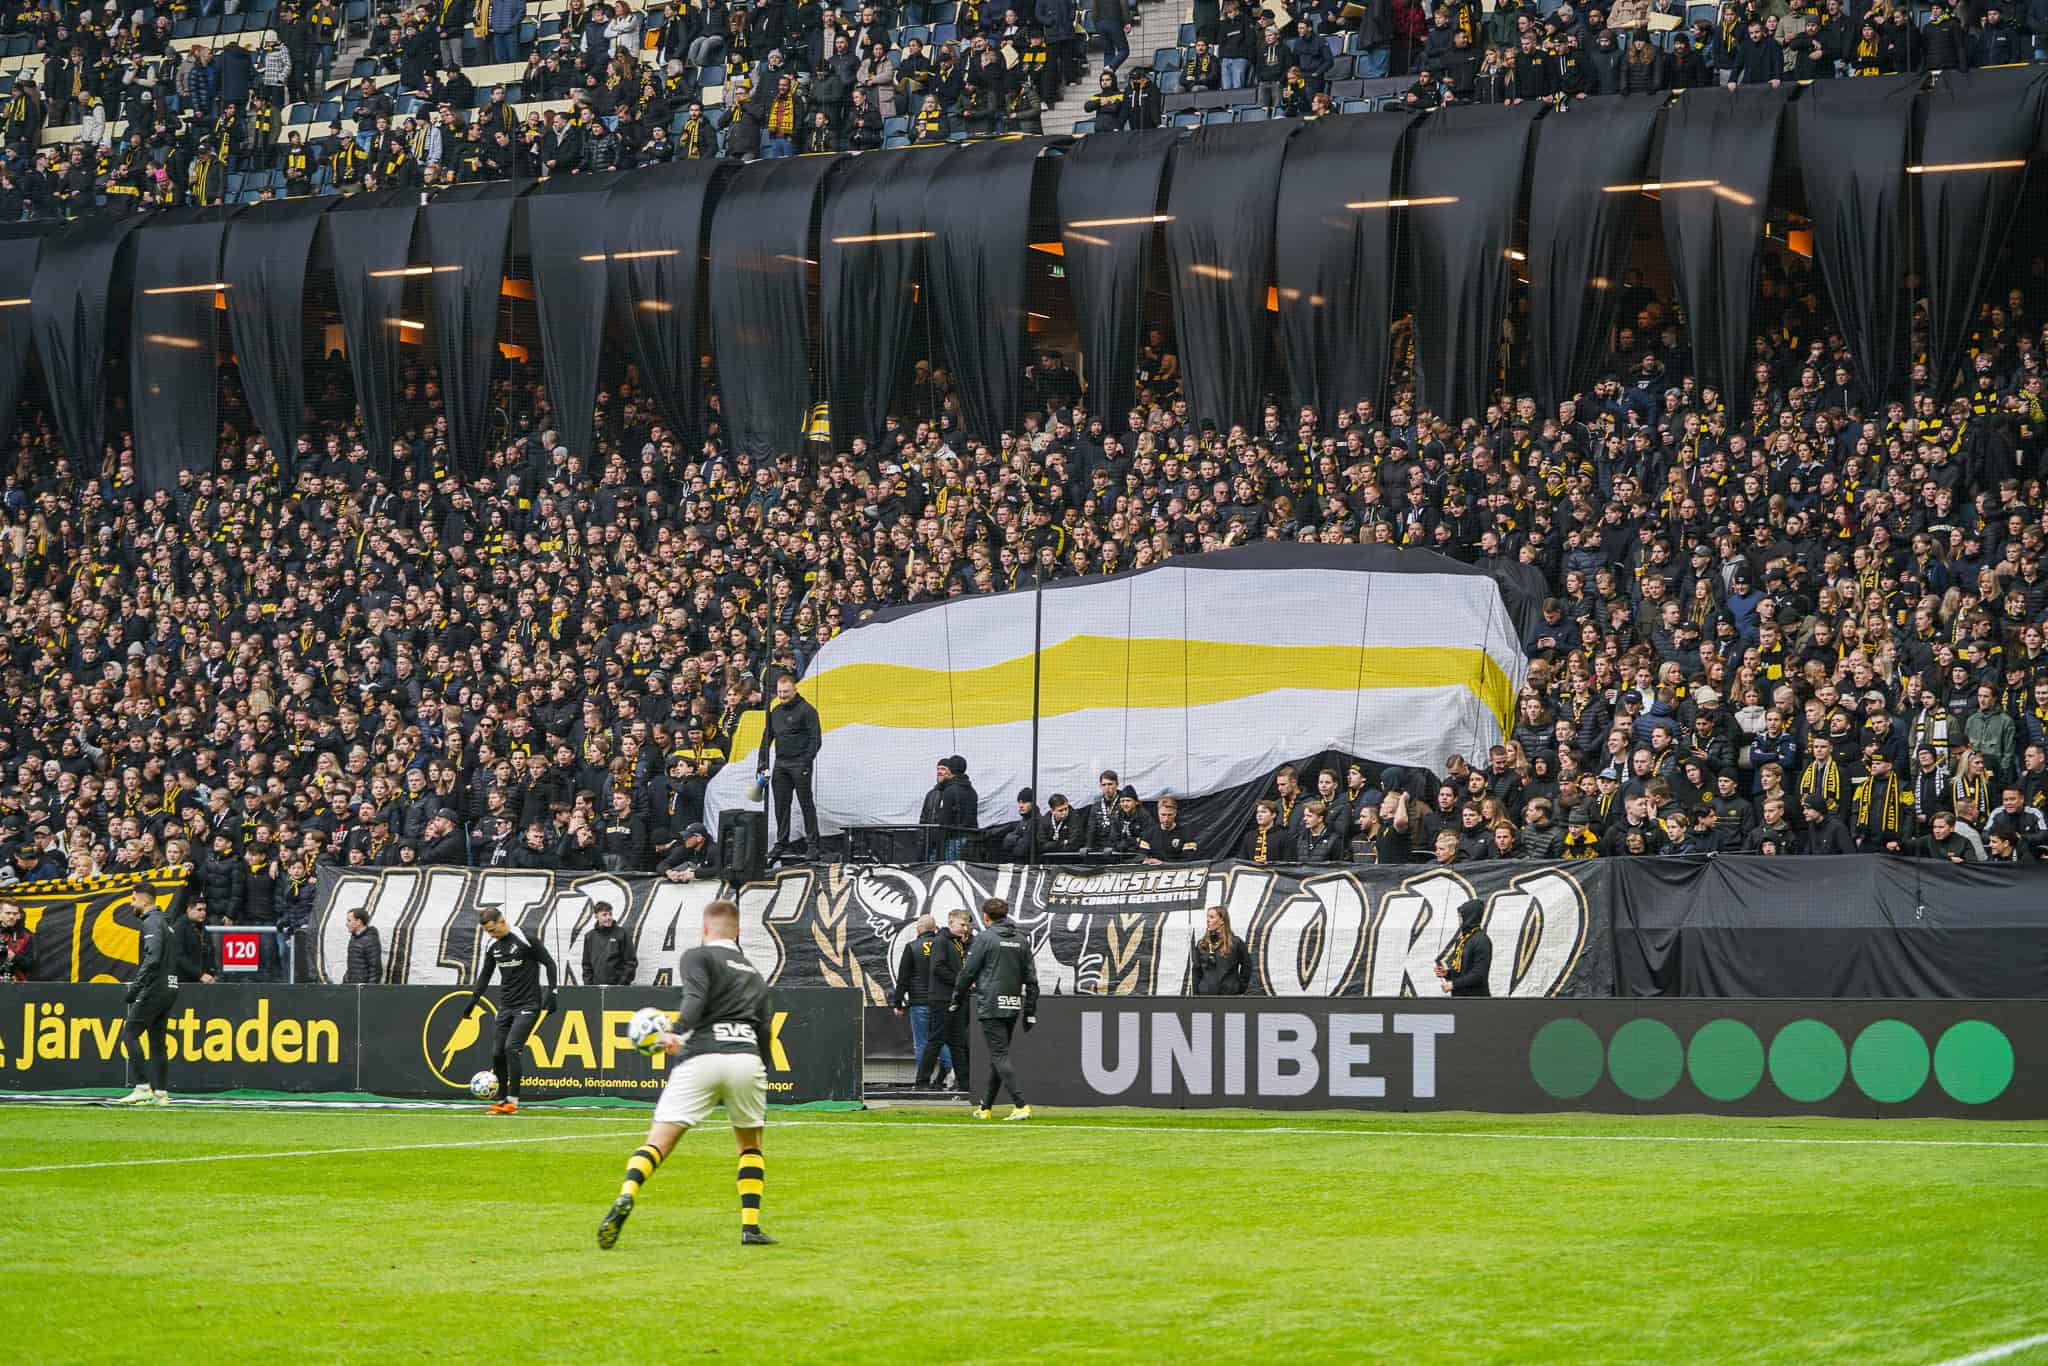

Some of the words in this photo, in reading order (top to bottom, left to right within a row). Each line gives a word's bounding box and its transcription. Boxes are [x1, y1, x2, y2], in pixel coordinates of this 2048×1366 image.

[1051, 868, 1208, 894] YOUNGSTERS
[317, 866, 813, 985] ULTRAS
[225, 941, 257, 959] 120
[1081, 1011, 1455, 1098] UNIBET
[640, 1078, 658, 1089] och
